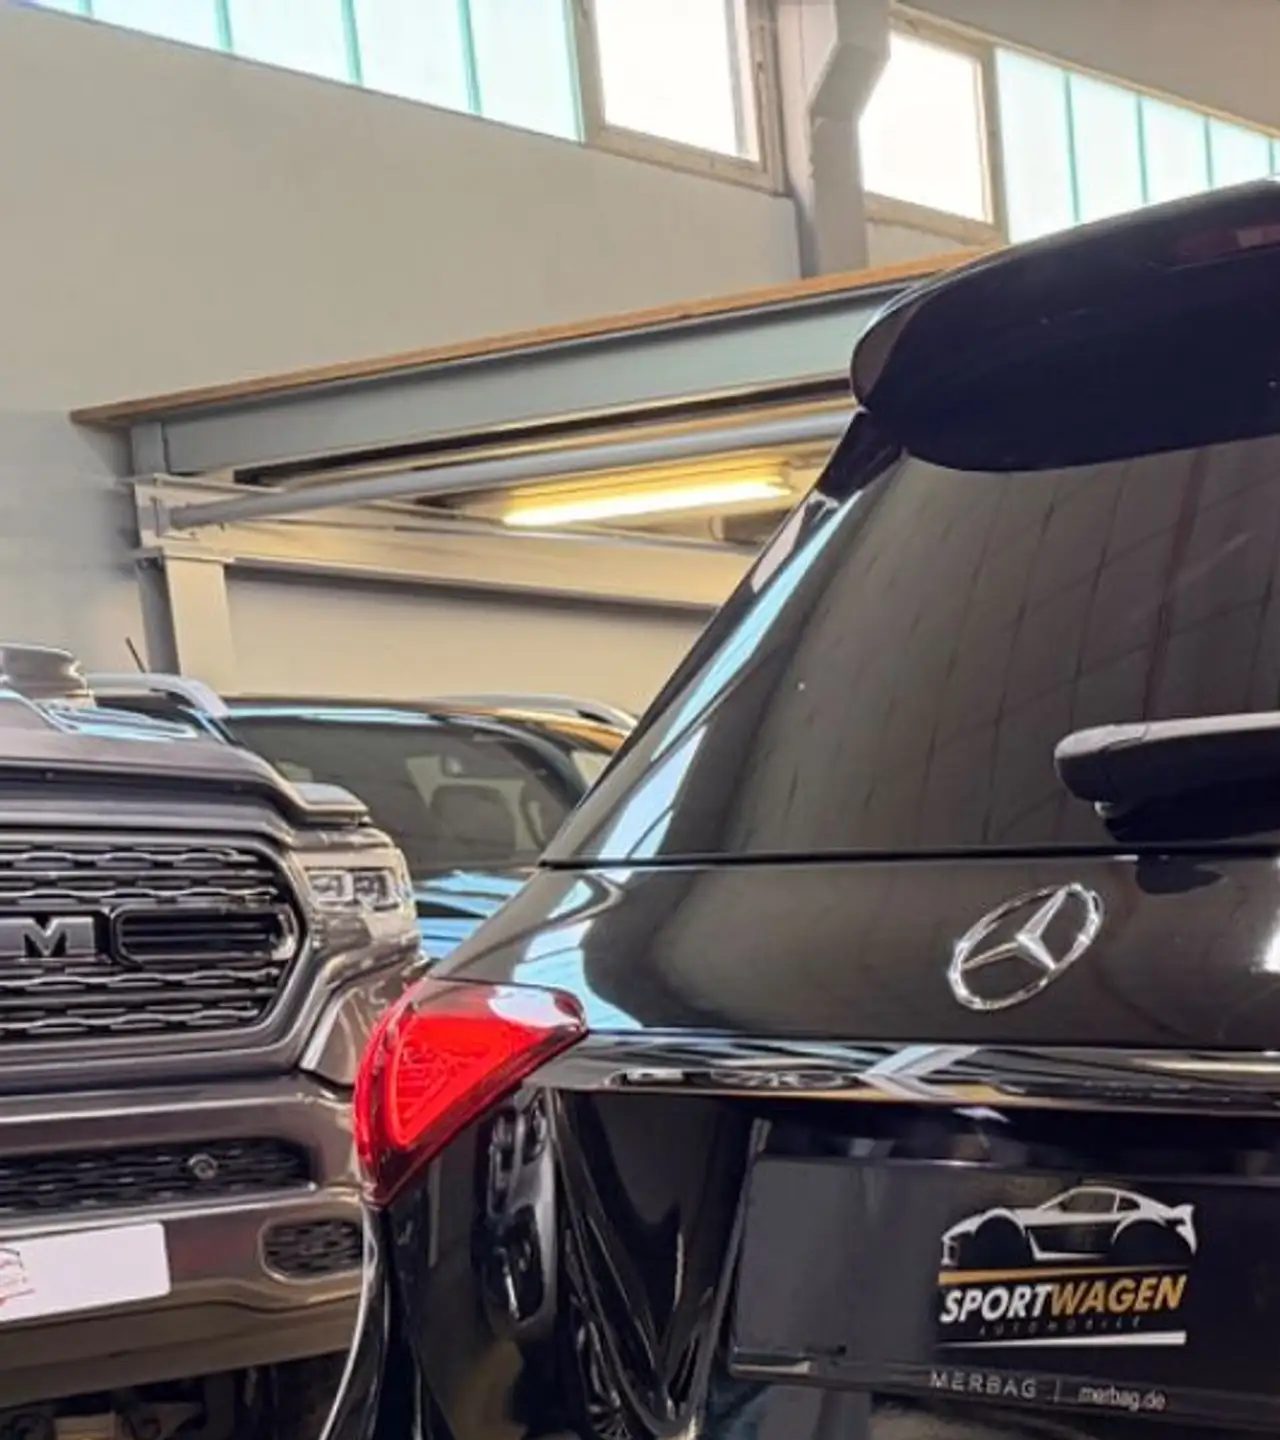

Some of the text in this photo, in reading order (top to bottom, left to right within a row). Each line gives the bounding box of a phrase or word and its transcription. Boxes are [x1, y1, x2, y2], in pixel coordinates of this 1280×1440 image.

[939, 1274, 1187, 1324] SPORTWAGEN
[929, 1370, 1167, 1412] MERBAG merbag.de
